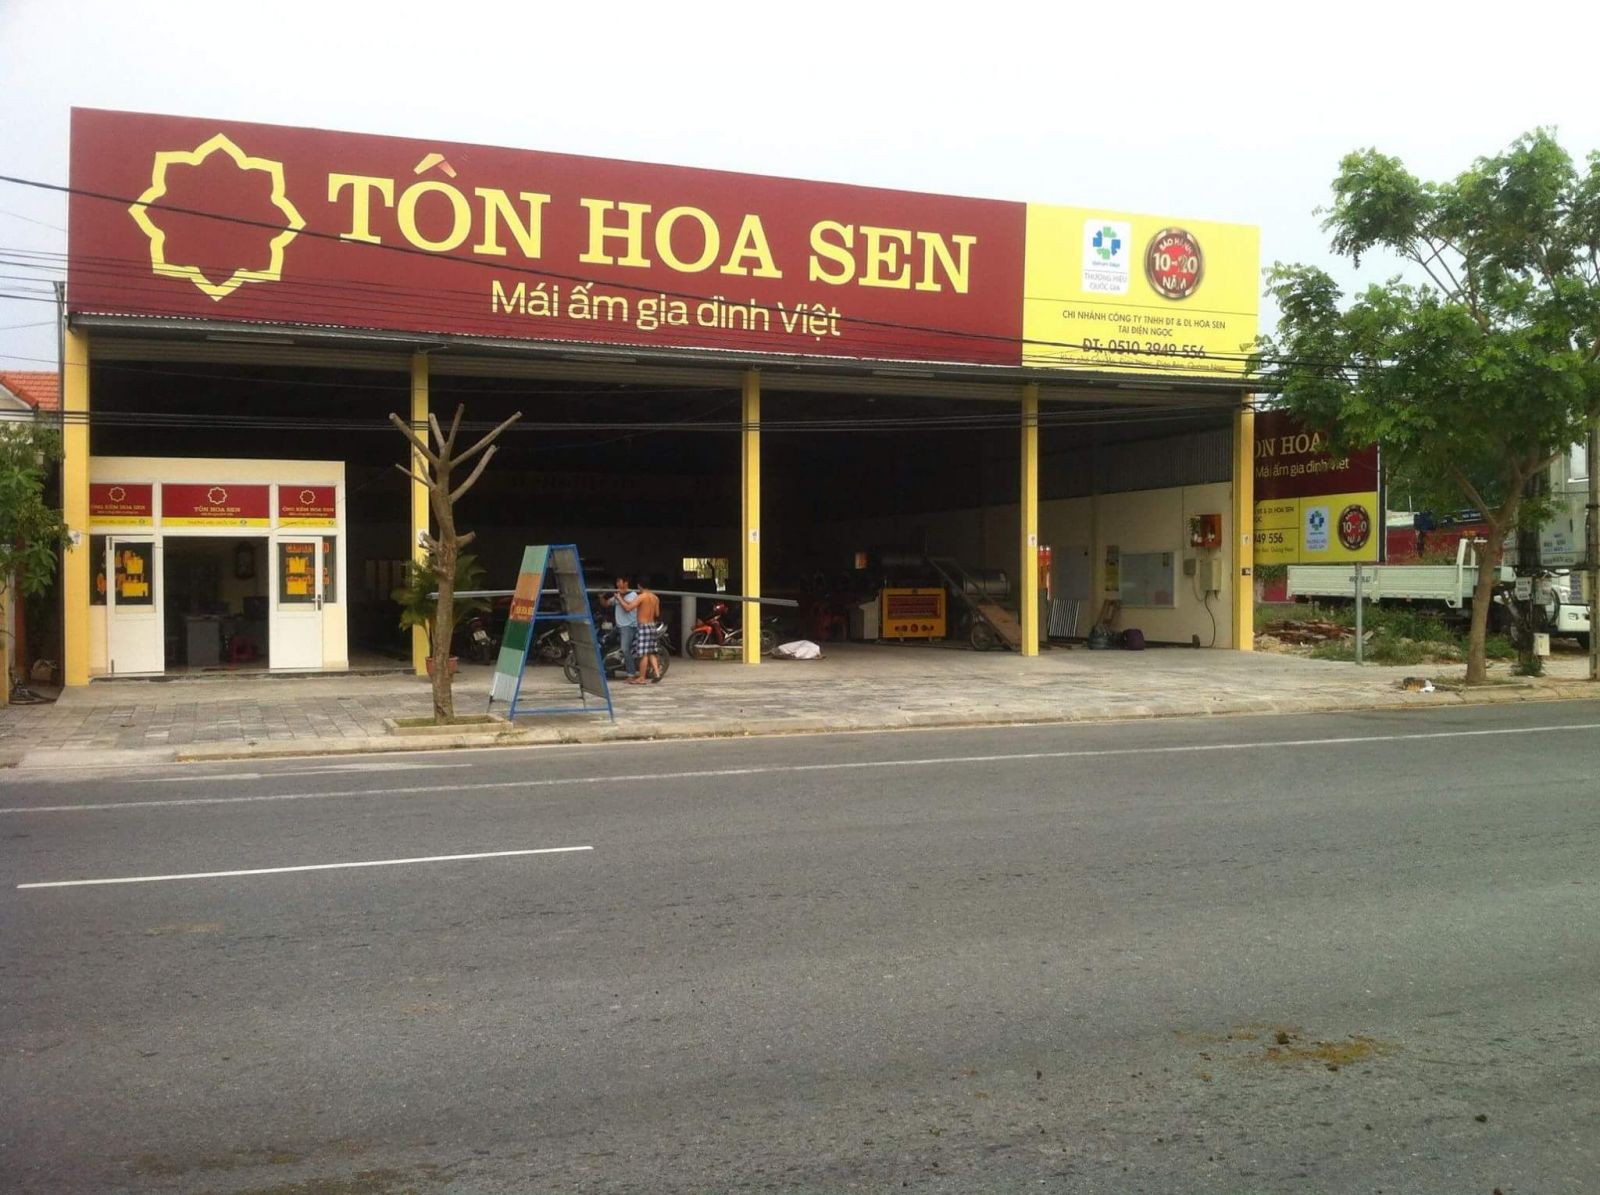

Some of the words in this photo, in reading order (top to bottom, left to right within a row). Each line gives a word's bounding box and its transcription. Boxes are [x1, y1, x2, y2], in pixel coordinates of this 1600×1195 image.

[328, 153, 551, 259] TÔN
[579, 197, 783, 279] HOA
[809, 219, 977, 294] SEN
[1153, 252, 1198, 274] 10-20
[491, 280, 559, 318] Mái
[567, 282, 628, 322] ấm
[636, 293, 689, 331] gia
[777, 301, 841, 341] Việt
[1062, 310, 1076, 319] CHI
[1077, 310, 1106, 321] NHÁNH
[1132, 315, 1142, 323] TY
[1212, 320, 1226, 329] SEN
[1108, 339, 1140, 354] 0510
[1268, 532, 1283, 544] 556
